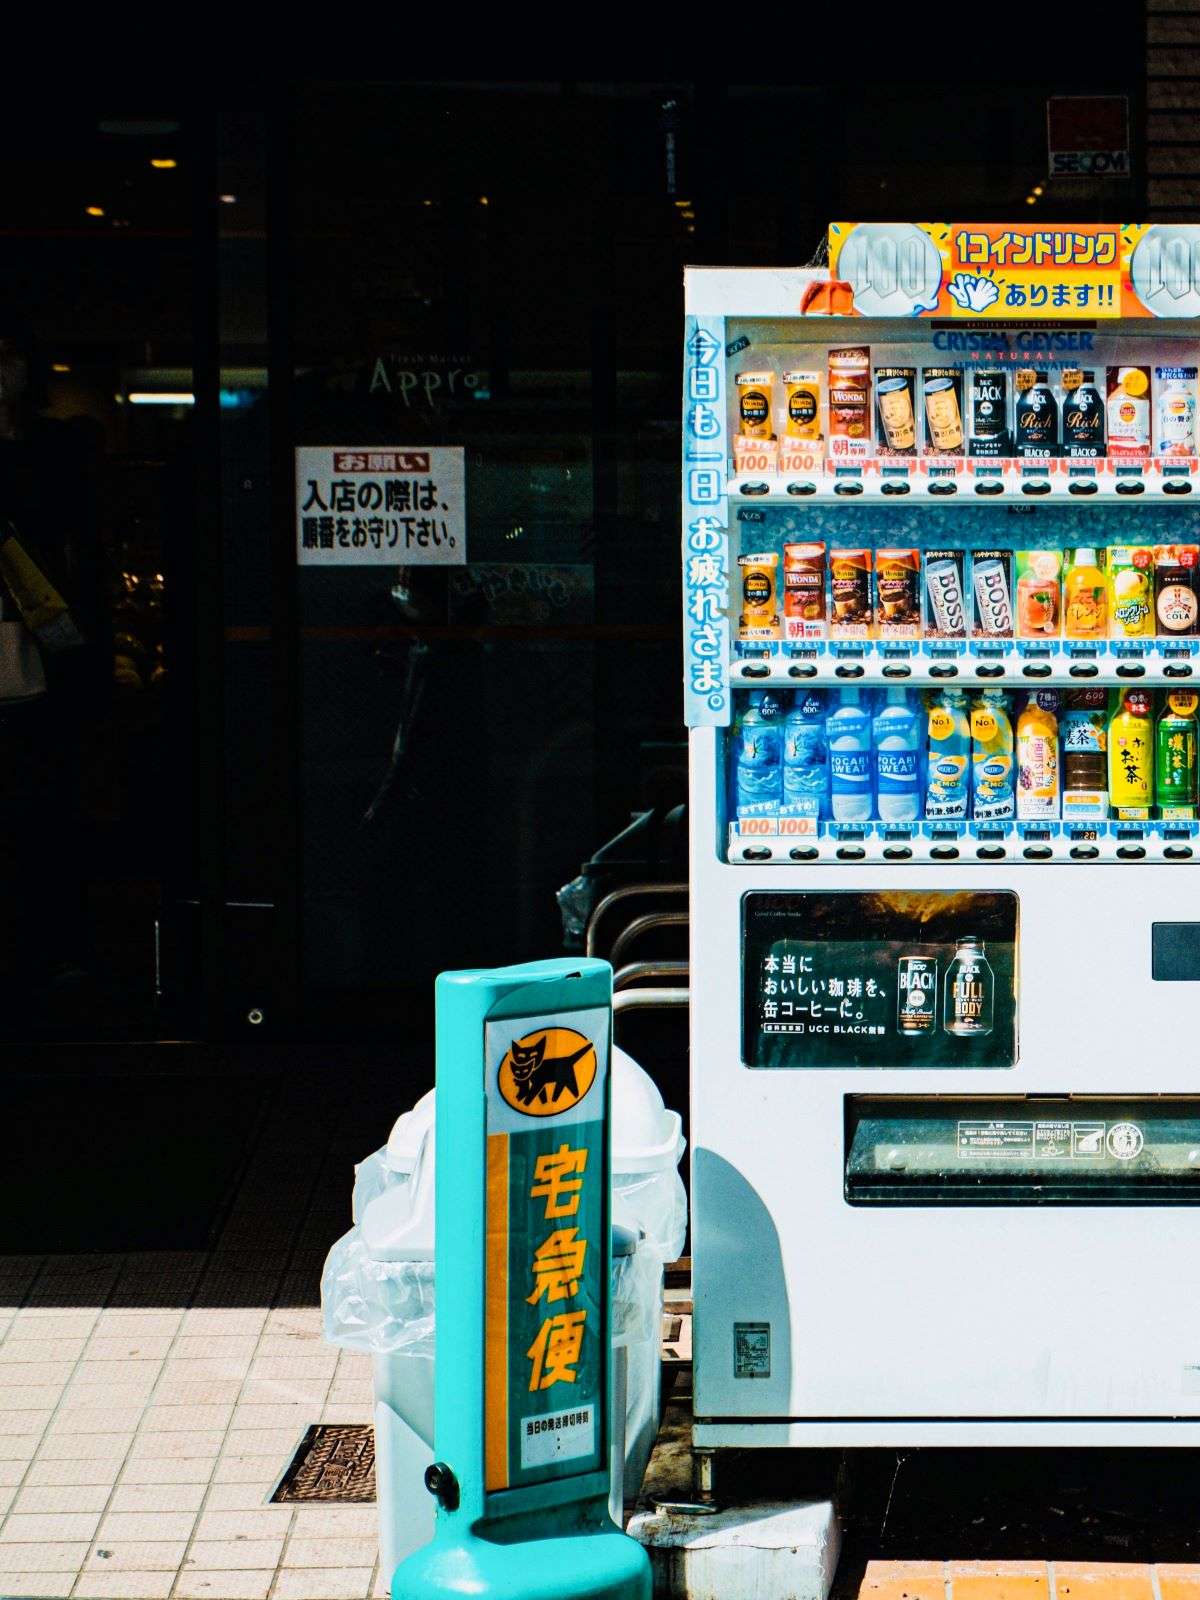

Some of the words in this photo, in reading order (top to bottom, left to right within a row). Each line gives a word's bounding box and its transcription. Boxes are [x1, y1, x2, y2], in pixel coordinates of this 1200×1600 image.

[956, 231, 1117, 265] 1コインドリンク
[1005, 284, 1114, 307] あります!!
[1016, 331, 1094, 351] GEYSER
[971, 352, 1056, 360] NATURAL
[1039, 361, 1080, 371] WATER
[370, 357, 479, 407] Appro
[833, 391, 864, 402] WONDA
[970, 387, 1001, 400] BLACK
[1021, 412, 1051, 429] Rich
[1067, 412, 1099, 429] Rich
[337, 454, 427, 471] お願い
[302, 480, 448, 512] 入店の際は、
[302, 516, 456, 549] 順番をお守り下さい。
[787, 574, 820, 584] WONDA
[940, 570, 964, 632] BOSS
[985, 572, 1010, 630] BOSS
[763, 955, 813, 974] 本当に
[763, 978, 887, 998] おいしい珈琲を、
[900, 973, 935, 989] BLACK
[952, 982, 985, 999] FULL
[763, 1000, 864, 1020] 缶コーヒーに。
[954, 1001, 983, 1016] BODY
[808, 1025, 830, 1034] UCC
[525, 1144, 588, 1392] 宅急便
